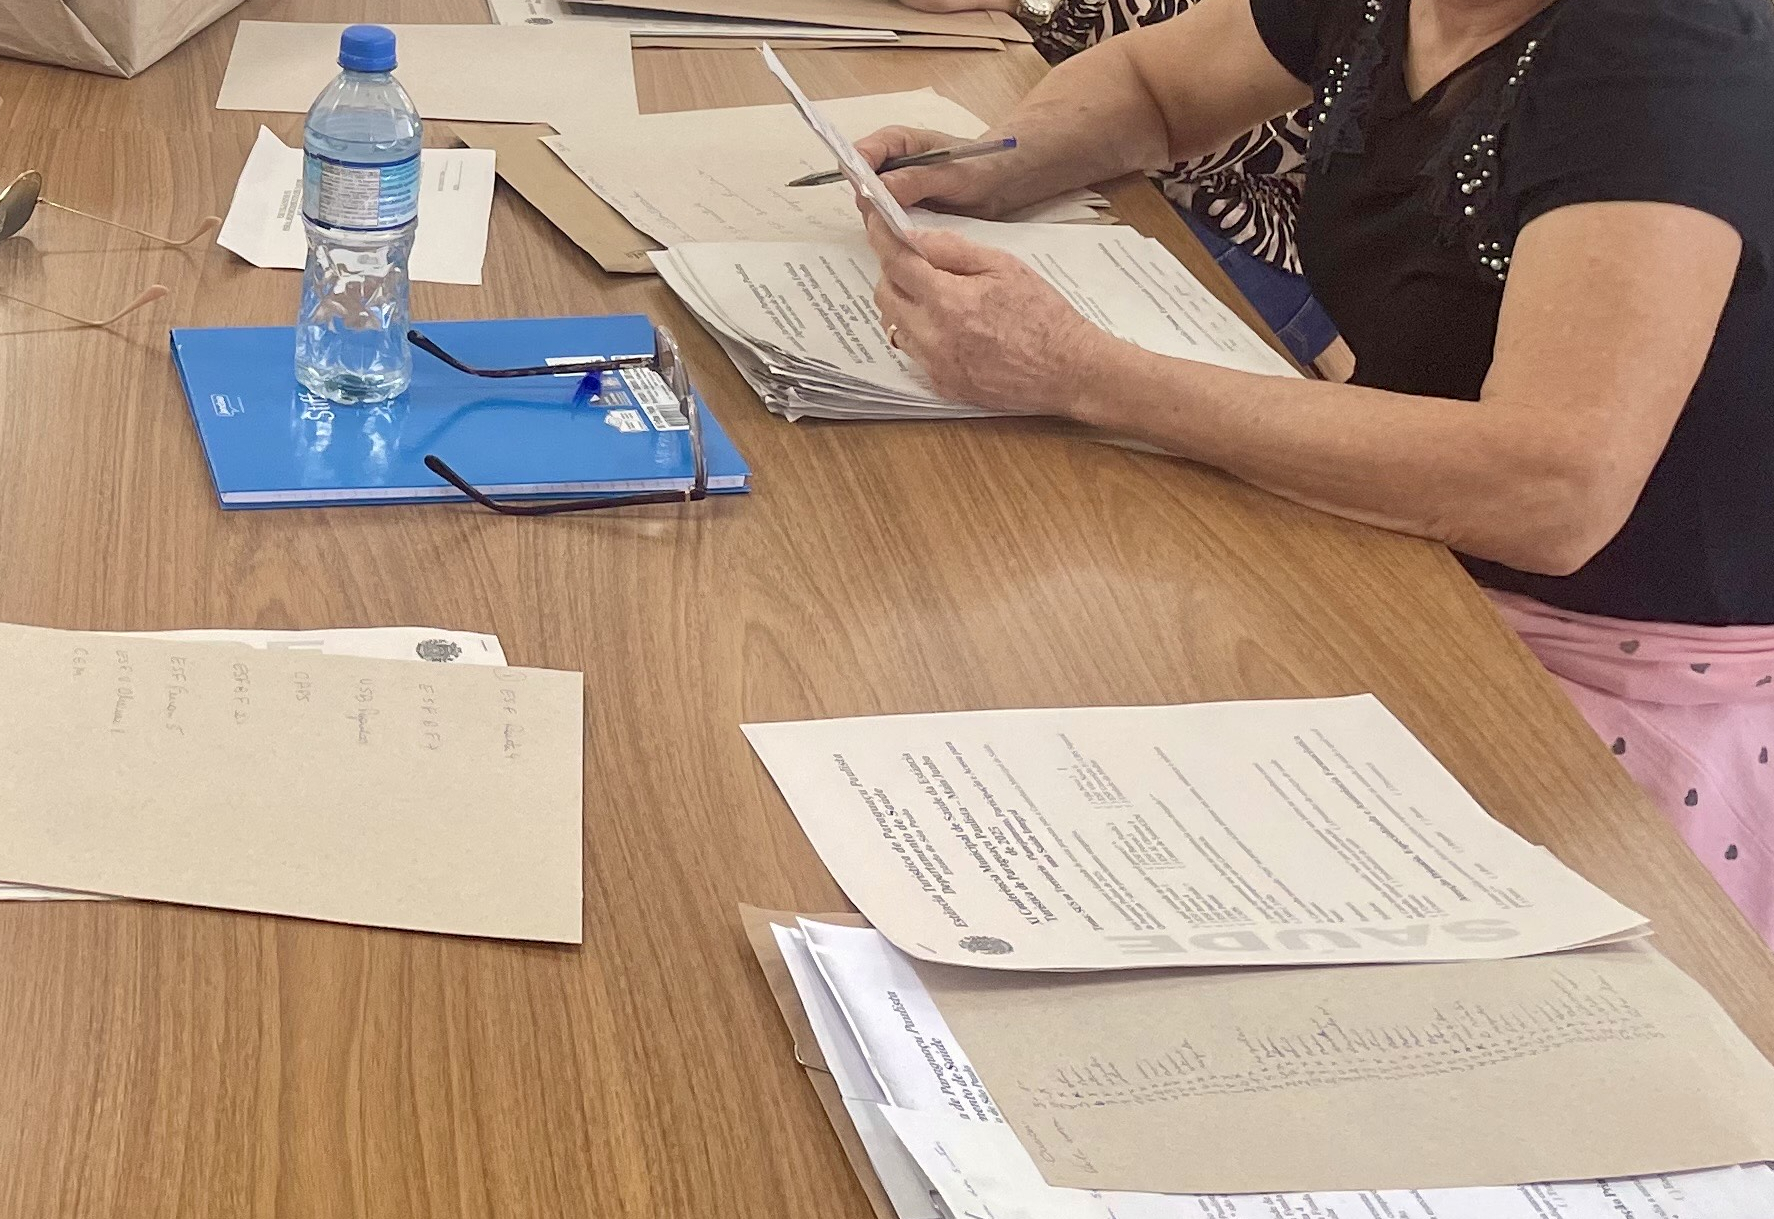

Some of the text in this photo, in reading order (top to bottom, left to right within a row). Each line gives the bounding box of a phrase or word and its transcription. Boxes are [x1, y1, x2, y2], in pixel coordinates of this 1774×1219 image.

[901, 752, 931, 785] Estância
[924, 785, 939, 796] da
[932, 796, 956, 822] Saúde
[958, 807, 987, 839] Paulista
[833, 753, 969, 928] Estância Turística de Paraguaçu Paulista
[873, 787, 956, 895] Departamento de Saúde
[950, 822, 964, 833] de
[987, 826, 1019, 857] de 2025
[956, 834, 994, 873] Municipal
[982, 840, 1020, 881] Paraguaçu
[989, 874, 1032, 916] Conferência
[1014, 881, 1029, 891] de
[1024, 891, 1057, 922] Turística
[887, 990, 919, 1034] Paulista
[914, 1036, 955, 1095] Paraguaçu
[930, 1037, 959, 1072] Saúde
[951, 1072, 968, 1087] de
[948, 1097, 965, 1112] de
